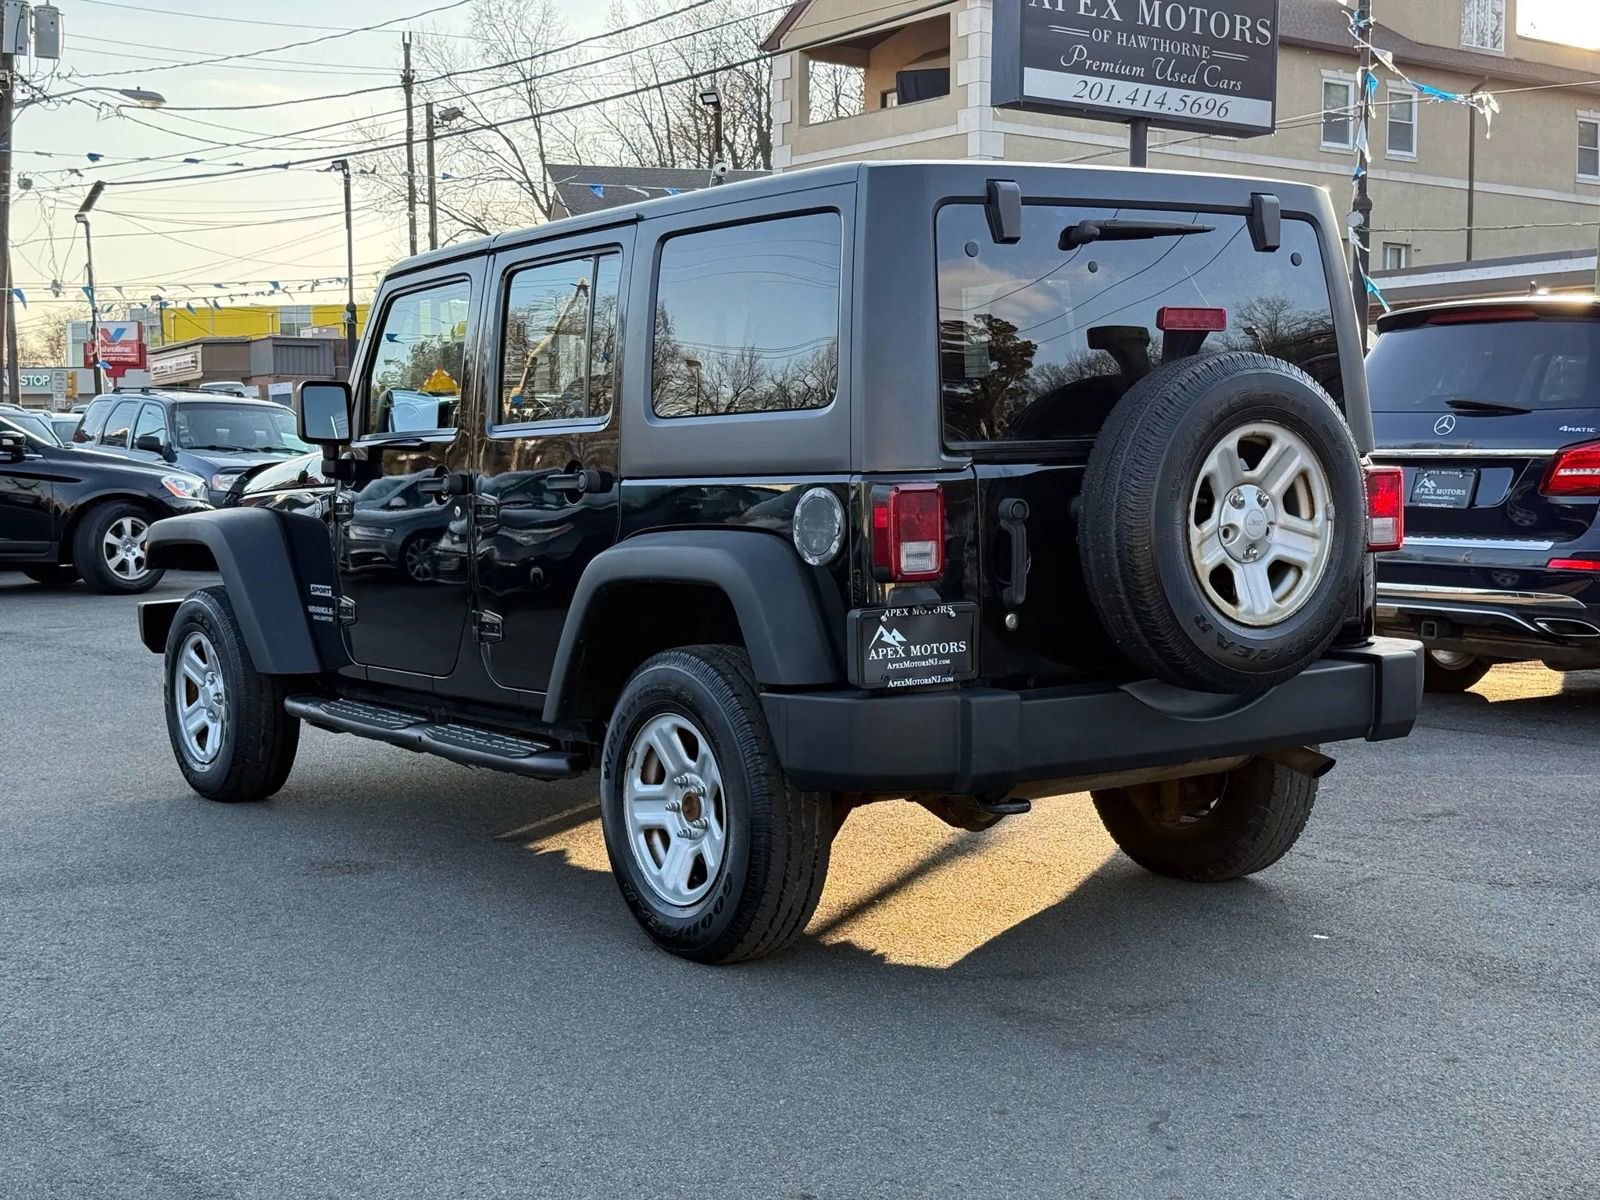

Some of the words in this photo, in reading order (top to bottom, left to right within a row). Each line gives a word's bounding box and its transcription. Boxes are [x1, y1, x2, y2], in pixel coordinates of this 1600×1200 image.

[1136, 0, 1271, 46] MOTORS
[1092, 28, 1112, 43] OF
[1117, 31, 1210, 59] HAWTHORNE
[1060, 44, 1145, 77] Premium
[1152, 57, 1207, 85] Used
[1203, 65, 1242, 91] Cars
[1072, 79, 1232, 119] 201.414.5696
[20, 375, 50, 386] STOP
[1558, 425, 1597, 433] 4MATIC
[1436, 488, 1466, 496] MOTORS
[884, 607, 909, 617] APEX
[868, 646, 906, 661] APEX
[910, 640, 967, 657] MOTORS
